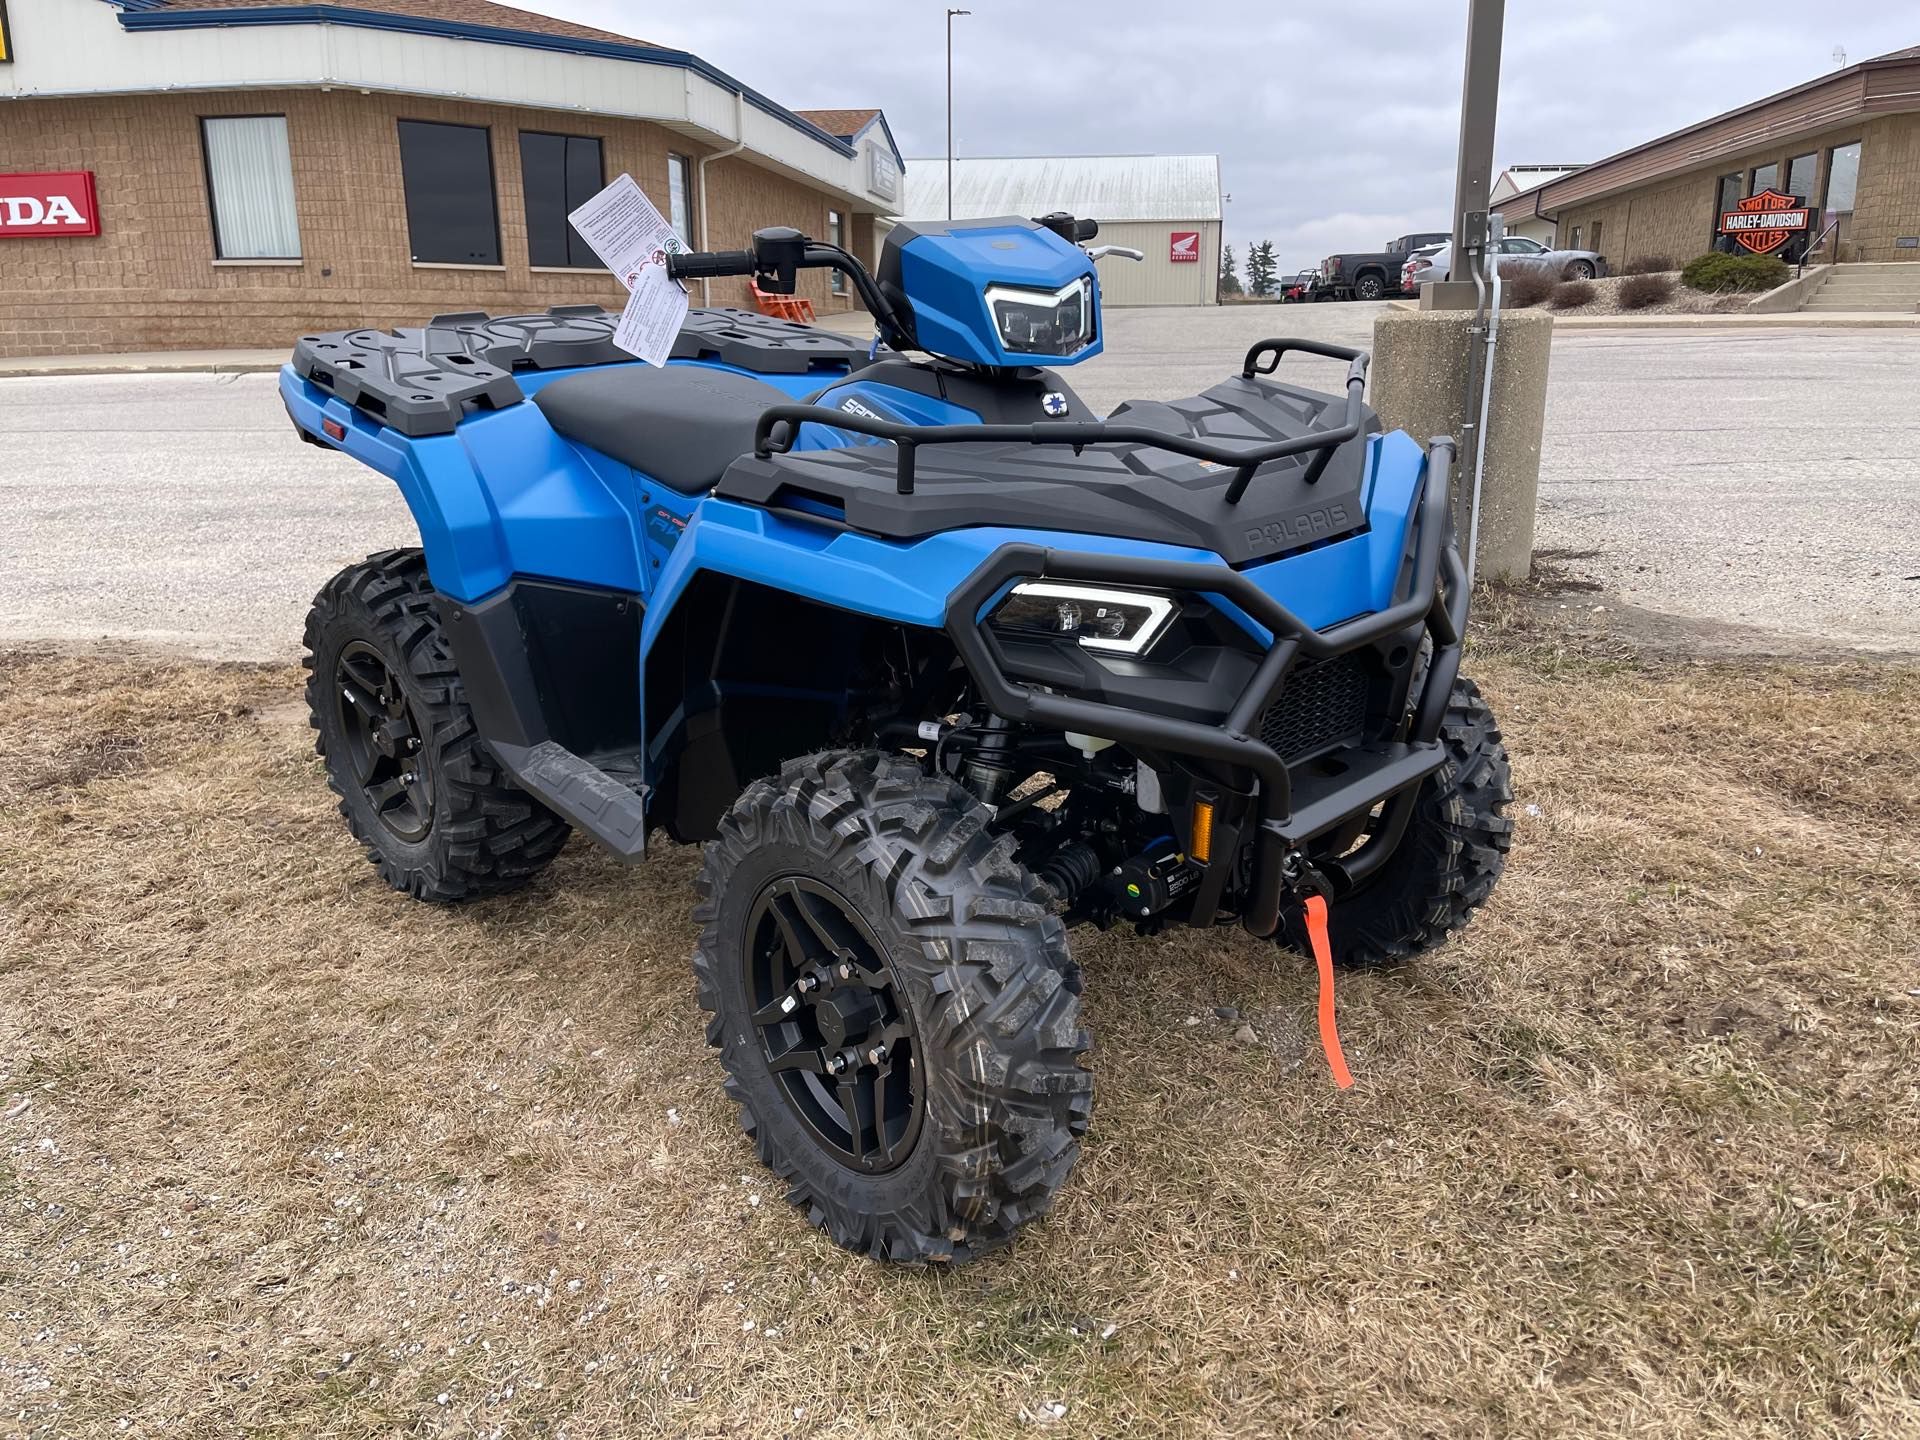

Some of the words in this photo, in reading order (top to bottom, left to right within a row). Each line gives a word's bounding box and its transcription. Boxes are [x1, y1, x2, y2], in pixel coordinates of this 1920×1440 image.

[0, 196, 86, 226] DA
[1746, 196, 1787, 211] MOTOR
[1726, 212, 1804, 230] HARLEY-DAVIDSON
[1742, 231, 1783, 250] CYCLES
[841, 398, 884, 421] SPO
[1244, 504, 1349, 551] POLARIS
